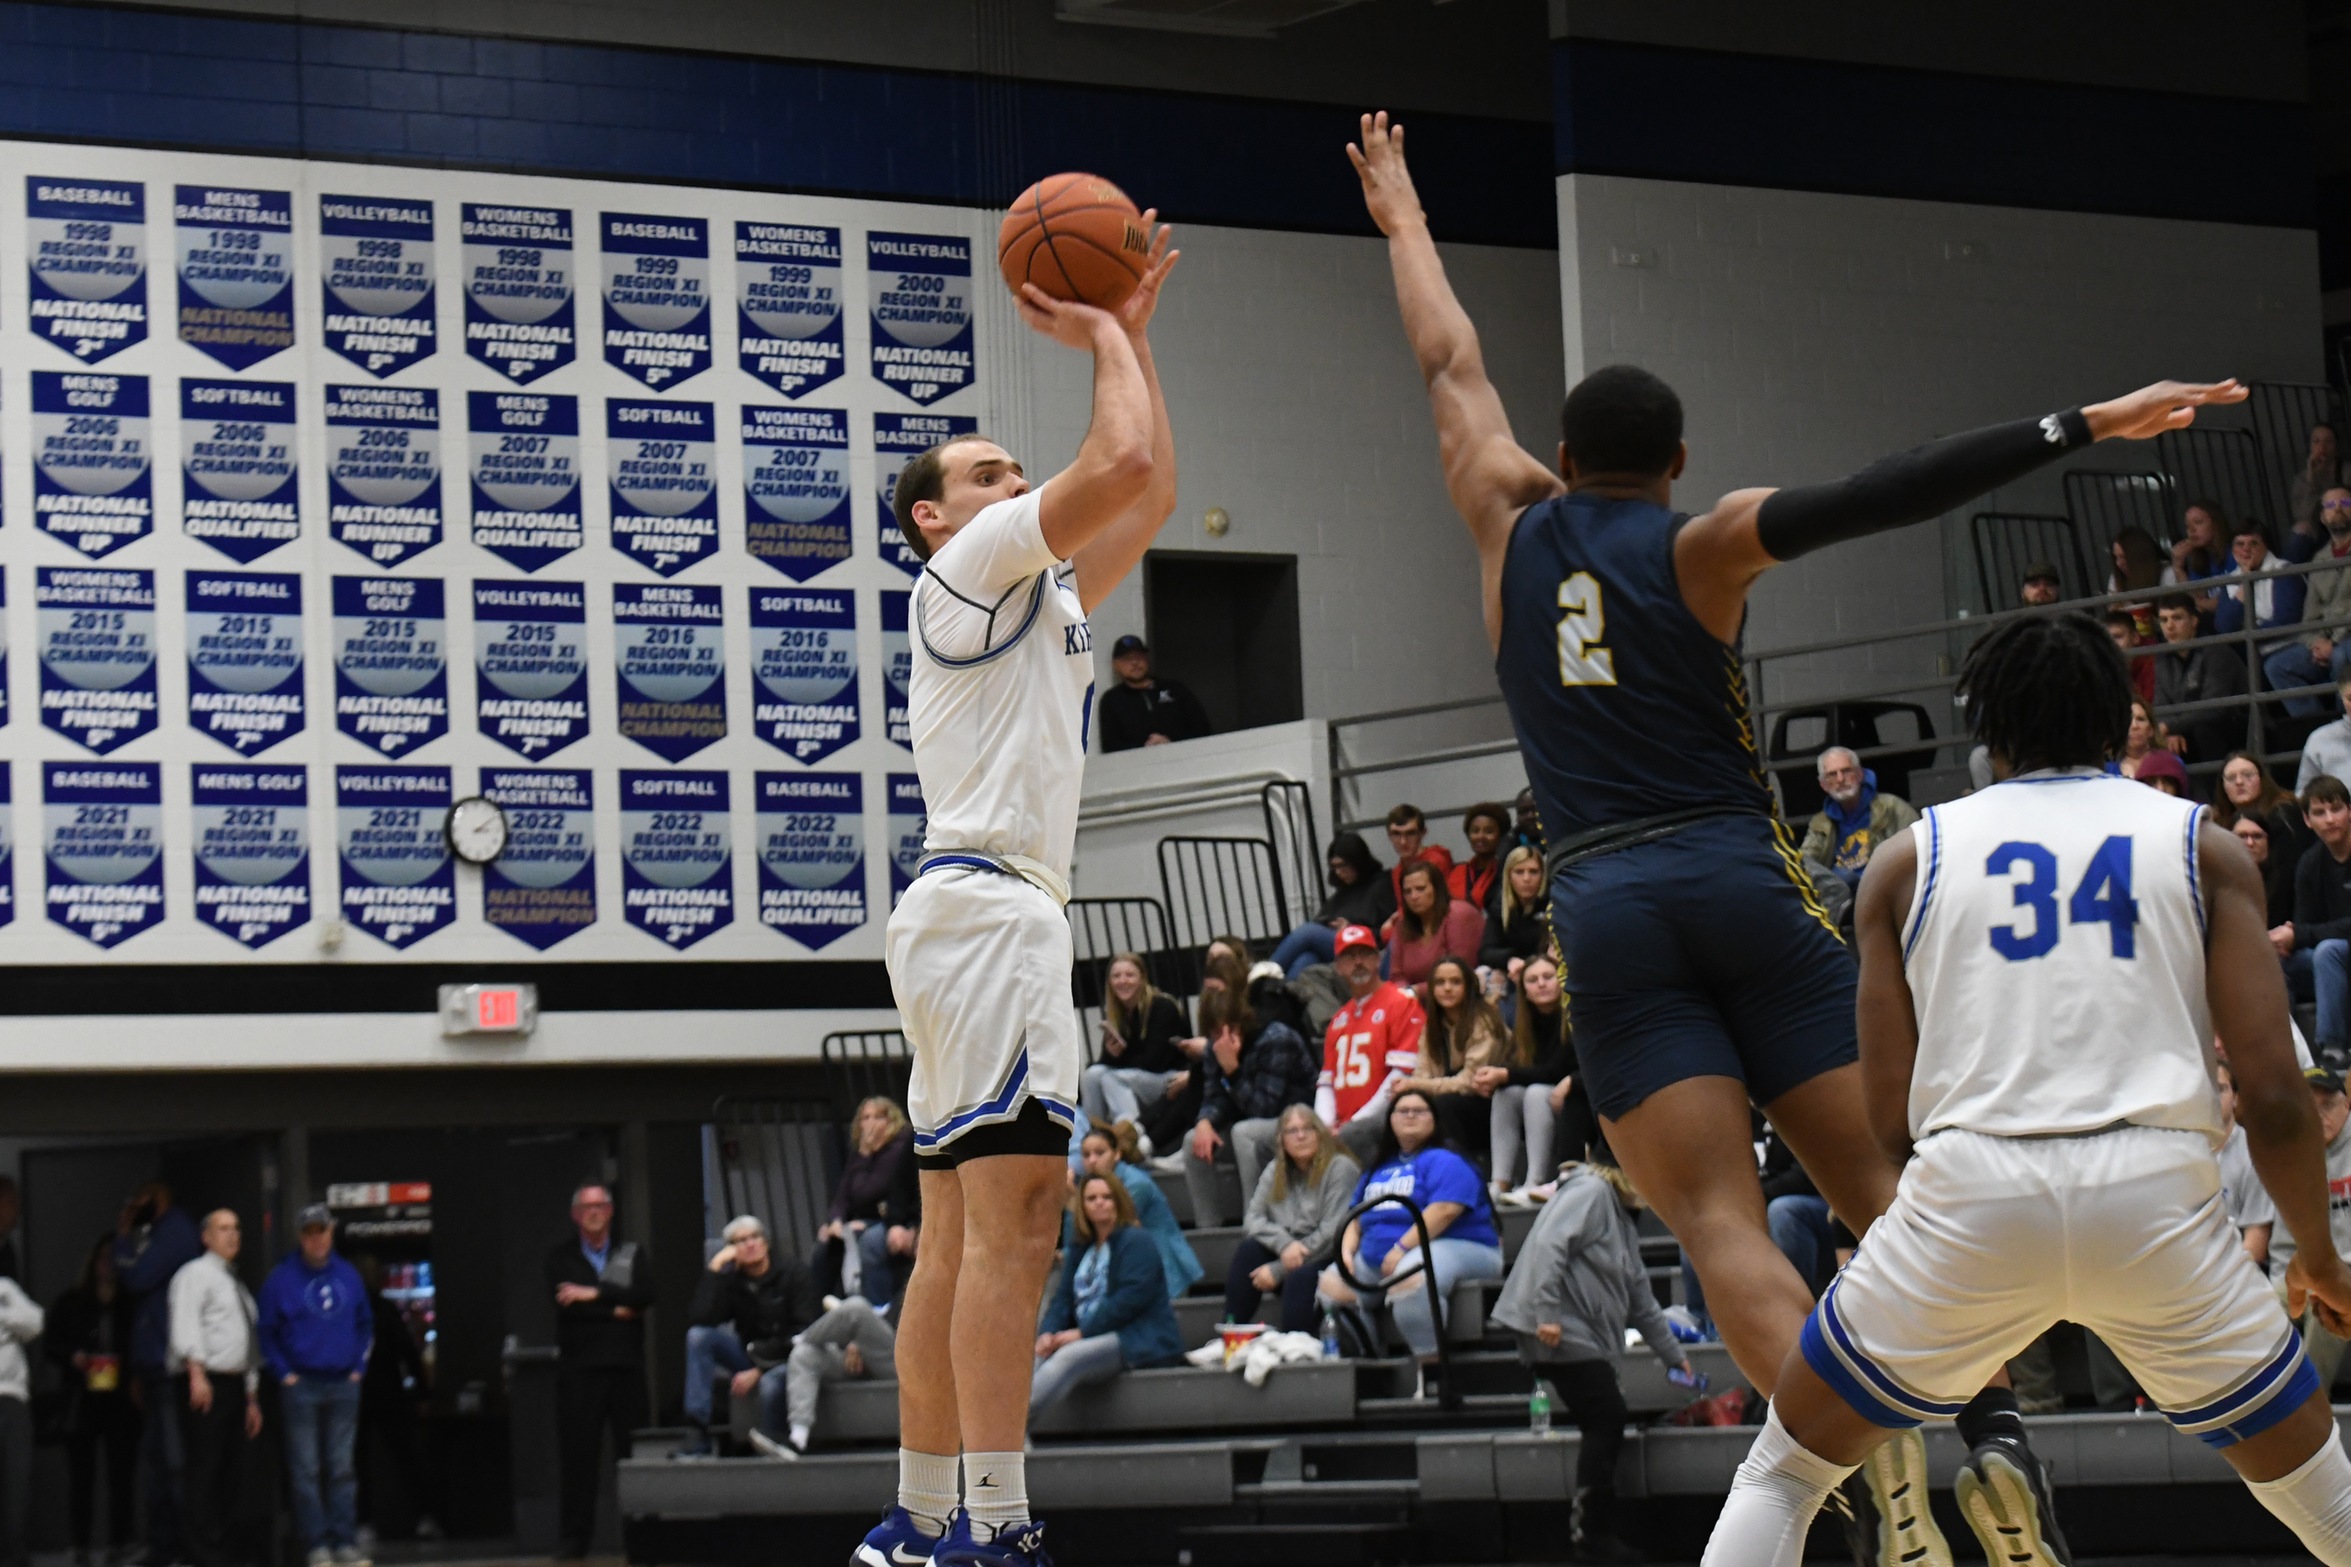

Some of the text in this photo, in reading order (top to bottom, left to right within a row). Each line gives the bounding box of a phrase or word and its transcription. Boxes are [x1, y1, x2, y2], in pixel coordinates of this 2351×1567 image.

[36, 185, 134, 206] BASEBALL
[204, 190, 261, 207] MENS
[175, 204, 290, 225] BASKETBALL
[322, 203, 430, 224] VOLLEYBALL
[475, 207, 558, 226] WOMENS
[62, 222, 111, 242] 1998
[211, 230, 259, 250] 1998
[462, 222, 571, 242] BASKETBALL
[610, 221, 698, 240] BASEBALL
[748, 225, 827, 244] WOMENS
[355, 238, 401, 259] 1998
[496, 247, 541, 267] 1998
[736, 239, 839, 260] BASKETBALL
[869, 239, 968, 260] VOLLEYBALL
[633, 255, 678, 275] 1999
[768, 264, 811, 284] 1999
[471, 281, 567, 300] CHAMPION
[747, 282, 832, 301] REGION XI
[896, 273, 944, 293] 2000
[610, 288, 703, 308] CHAMPION
[745, 297, 835, 316] CHAMPION
[878, 291, 963, 310] REGION XI
[31, 297, 146, 322] NATIONAL
[180, 305, 292, 329] NATIONAL
[877, 306, 966, 326] CHAMPION
[50, 317, 129, 339] FINISH
[324, 312, 434, 337] NATIONAL
[466, 320, 573, 344] NATIONAL
[180, 325, 294, 346] CHAMPION
[342, 332, 418, 353] FINISH
[604, 327, 709, 351] NATIONAL
[484, 340, 558, 361] FINISH
[621, 346, 693, 367] FINISH
[740, 335, 842, 359] NATIONAL
[872, 344, 972, 368] NATIONAL
[757, 354, 827, 375] FINISH
[883, 362, 965, 384] RUNNER
[61, 376, 118, 392] MENS
[910, 381, 940, 399] UP
[66, 392, 115, 408] GOLF
[190, 387, 284, 407] SOFTBALL
[338, 389, 424, 406] WOMENS
[495, 396, 549, 411] MENS
[326, 404, 438, 422] BASKETBALL
[501, 411, 546, 426] GOLF
[616, 407, 703, 425] SOFTBALL
[754, 410, 834, 427] WOMENS
[64, 416, 119, 436] 2006
[212, 422, 266, 441] 2006
[901, 416, 950, 432] MENS
[357, 429, 410, 447] 2006
[498, 434, 550, 453] 2007
[743, 425, 846, 443] BASKETBALL
[636, 441, 687, 459] 2007
[771, 447, 820, 465] 2007
[477, 469, 574, 487] CHAMPION
[753, 465, 839, 482] REGION XI
[616, 475, 710, 493] CHAMPION
[751, 481, 843, 498] CHAMPION
[35, 493, 150, 517] NATIONAL
[184, 498, 297, 522] NATIONAL
[47, 513, 142, 534] RUNNER
[330, 504, 440, 526] NATIONAL
[472, 509, 580, 530] NATIONAL
[184, 517, 299, 539] QUALIFIER
[342, 523, 432, 543] RUNNER
[611, 514, 716, 536] NATIONAL
[746, 520, 849, 541] NATIONAL
[78, 533, 113, 552] UP
[472, 527, 582, 548] QUALIFIER
[629, 533, 701, 553] FINISH
[371, 542, 404, 560] UP
[746, 539, 850, 558] CHAMPION
[50, 571, 140, 588] WOMENS
[360, 580, 414, 595] MENS
[37, 587, 154, 604] BASKETBALL
[196, 580, 289, 599] SOFTBALL
[475, 588, 581, 606] VOLLEYBALL
[640, 588, 694, 602] MENS
[365, 596, 411, 610] GOLF
[614, 602, 721, 619] BASKETBALL
[759, 596, 845, 613] SOFTBALL
[69, 611, 124, 630] 2015
[217, 615, 271, 634] 2015
[363, 620, 415, 638] 2015
[1556, 570, 1618, 687] 2
[504, 623, 556, 641] 2015
[644, 626, 695, 644] 2016
[779, 629, 829, 647] 2016
[484, 658, 580, 675] CHAMPION
[623, 661, 718, 678] CHAMPION
[759, 664, 851, 680] CHAMPION
[41, 690, 156, 711] NATIONAL
[190, 692, 302, 714] NATIONAL
[337, 696, 446, 717] NATIONAL
[479, 698, 586, 719] NATIONAL
[60, 710, 139, 729] FINISH
[619, 701, 725, 721] NATIONAL
[755, 703, 858, 723] NATIONAL
[208, 711, 286, 731] FINISH
[355, 715, 430, 734] FINISH
[496, 717, 571, 736] FINISH
[619, 720, 726, 739] CHAMPION
[771, 721, 843, 740] FINISH
[53, 771, 149, 787] BASEBALL
[197, 773, 303, 790] MENS GOLF
[338, 775, 448, 790] VOLLEYBALL
[493, 773, 578, 788] WOMENS
[629, 779, 718, 795] SOFTBALL
[765, 780, 852, 796] BASEBALL
[75, 805, 130, 823] 2021
[223, 807, 277, 824] 2021
[368, 808, 422, 825] 2021
[511, 811, 564, 829] 2022
[650, 812, 701, 829] 2022
[785, 814, 835, 831] 2022
[629, 847, 724, 863] CHAMPION
[765, 849, 857, 864] CHAMPION
[47, 884, 162, 904] NATIONAL
[196, 885, 308, 904] NATIONAL
[341, 886, 453, 905] NATIONAL
[484, 886, 594, 906] NATIONAL
[625, 887, 731, 906] NATIONAL
[760, 889, 864, 908] NATIONAL
[1985, 834, 2139, 962] 34
[66, 904, 145, 922] FINISH
[214, 904, 291, 922] FINISH
[359, 905, 437, 922] FINISH
[484, 905, 595, 923] CHAMPION
[642, 905, 716, 923] FINISH
[760, 907, 865, 925] QUALIFIER
[478, 990, 518, 1027] EXIT
[1334, 1031, 1371, 1090] 15
